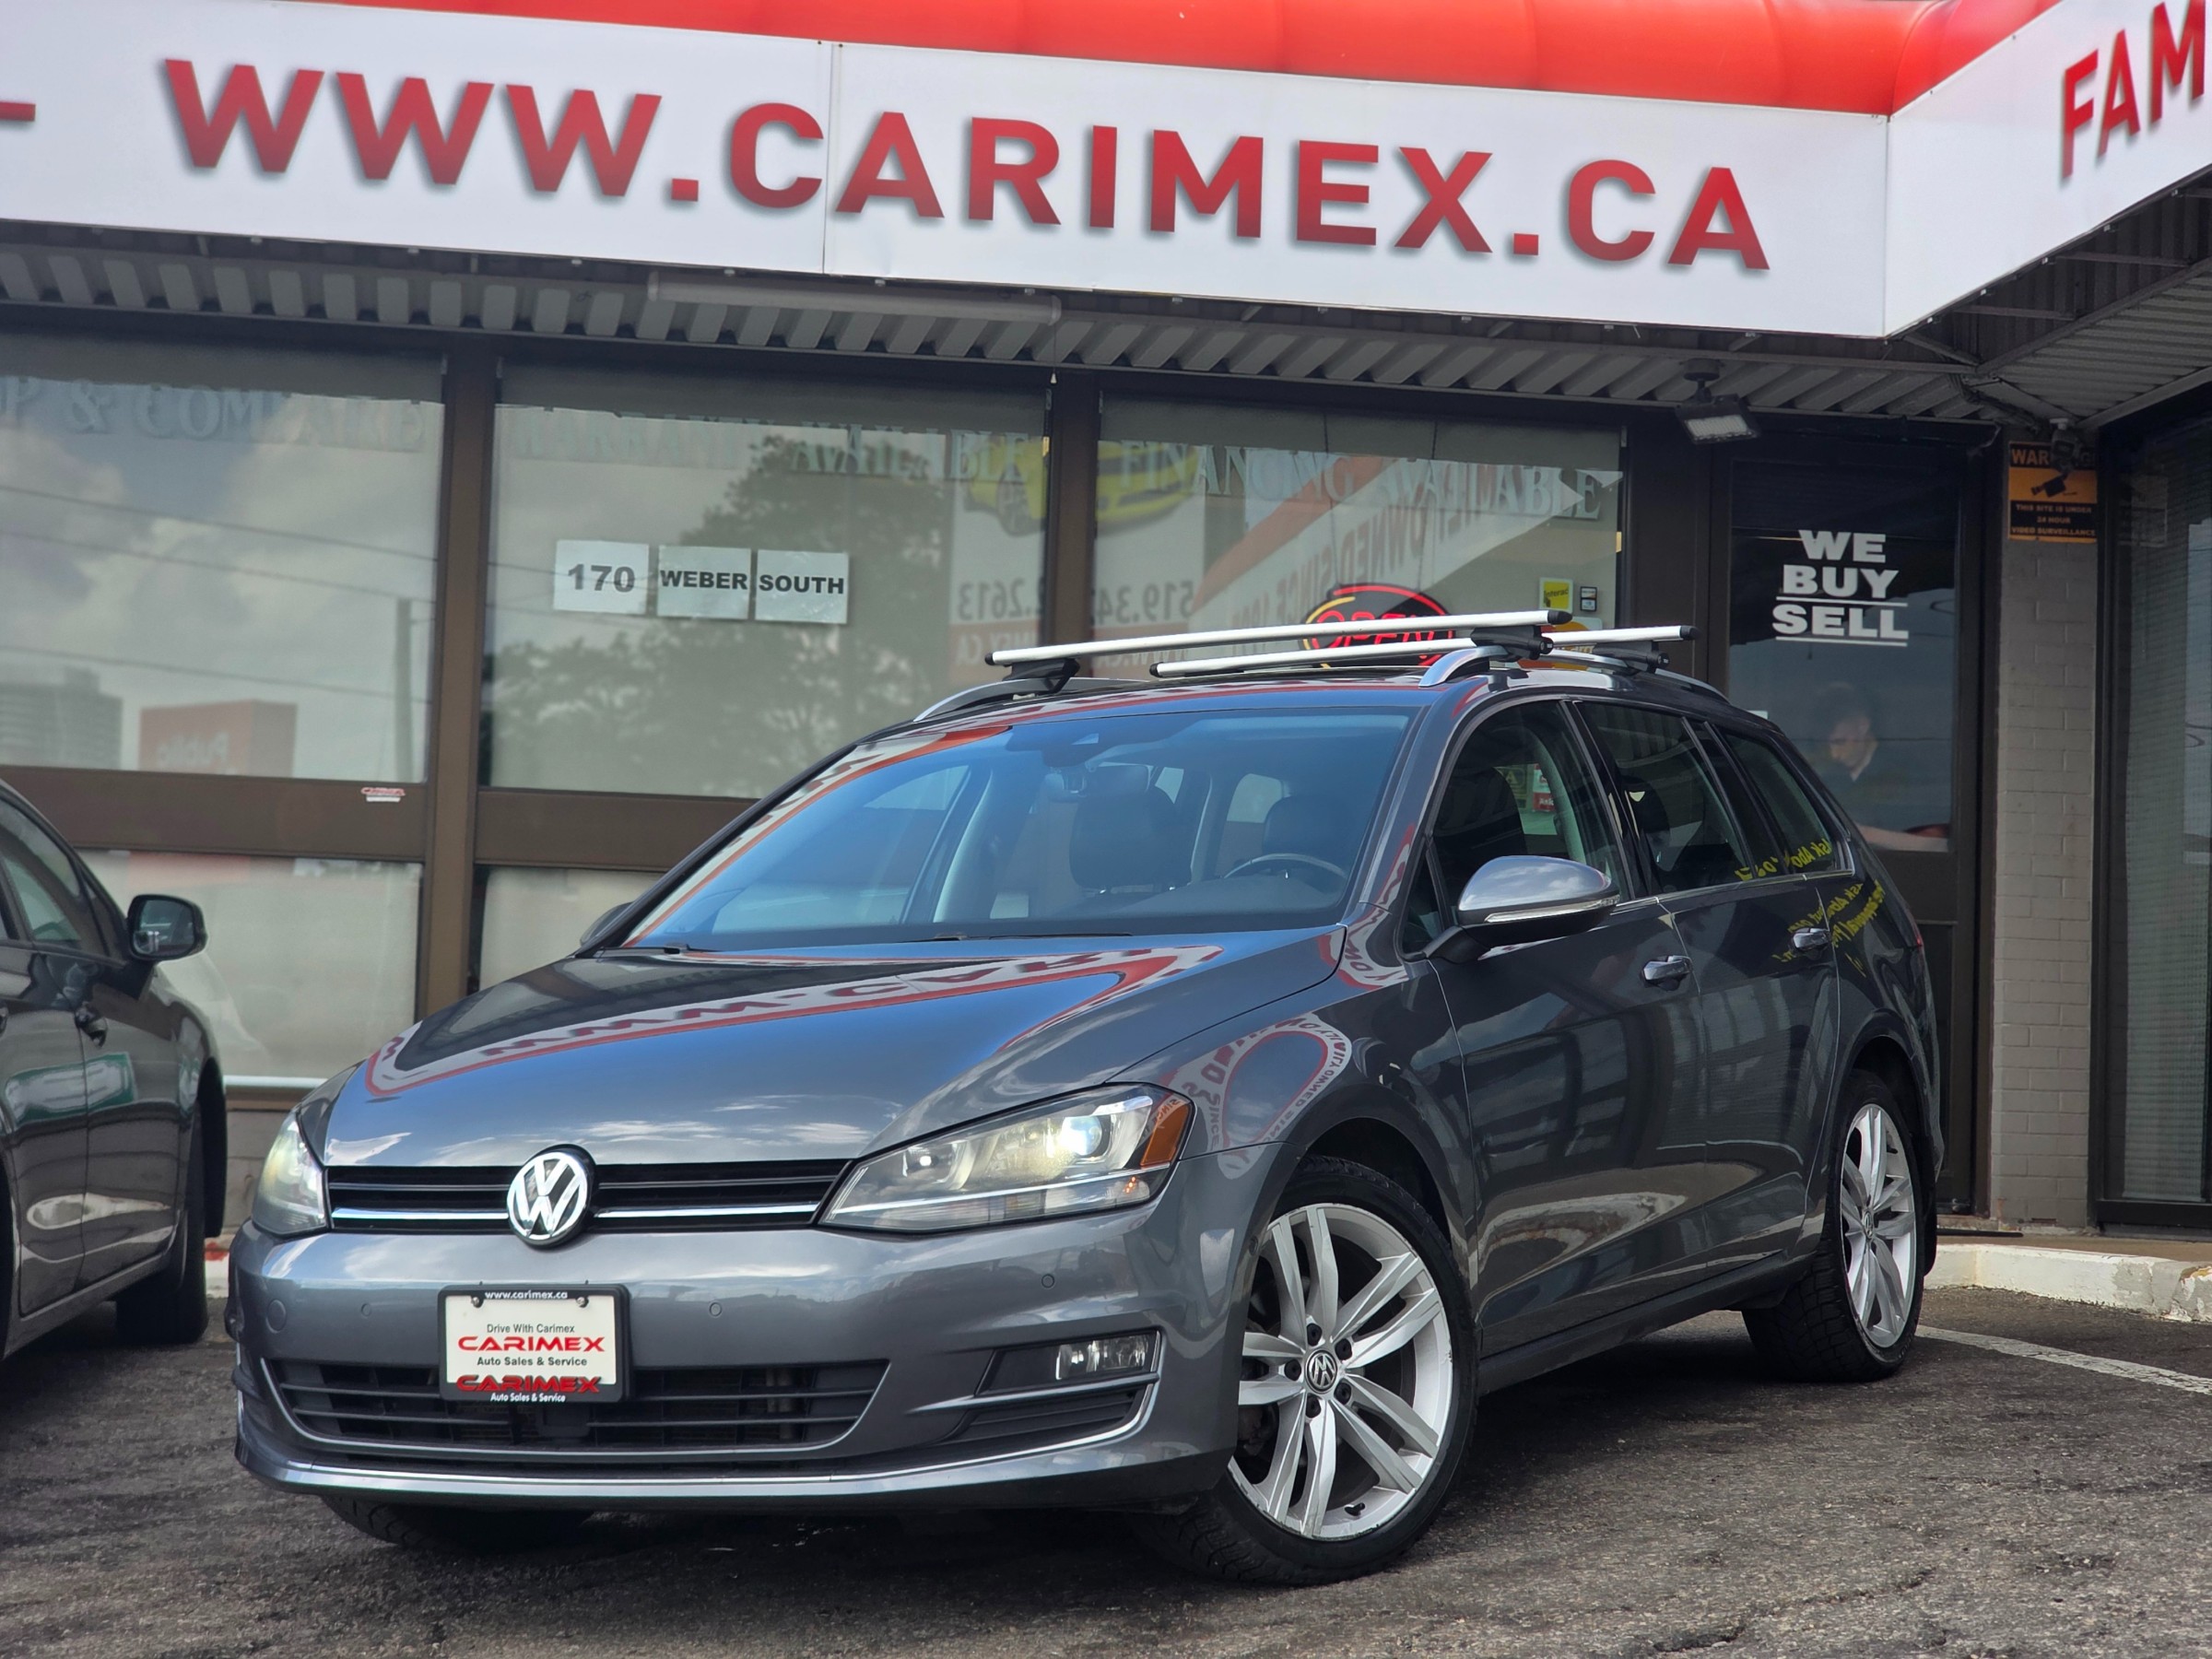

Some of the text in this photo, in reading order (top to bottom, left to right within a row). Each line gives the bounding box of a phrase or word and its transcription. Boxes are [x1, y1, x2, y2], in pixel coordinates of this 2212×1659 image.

[165, 58, 1771, 270] WWW.CARIMEX.CA
[2011, 448, 2091, 466] WARG
[1798, 529, 1887, 563] WE
[568, 563, 845, 594] 170 WEBER SOUTH
[1783, 564, 1900, 598] BUY
[1771, 604, 1910, 640] SELL
[484, 1289, 569, 1300] www.carimex.ca
[487, 1324, 575, 1334] Drive With Carimex
[457, 1335, 606, 1352] CARIMEX
[477, 1356, 588, 1366] Auto Sales & Service
[455, 1374, 602, 1394] CARIMEX
[489, 1392, 566, 1403] Auto Sales & Service
